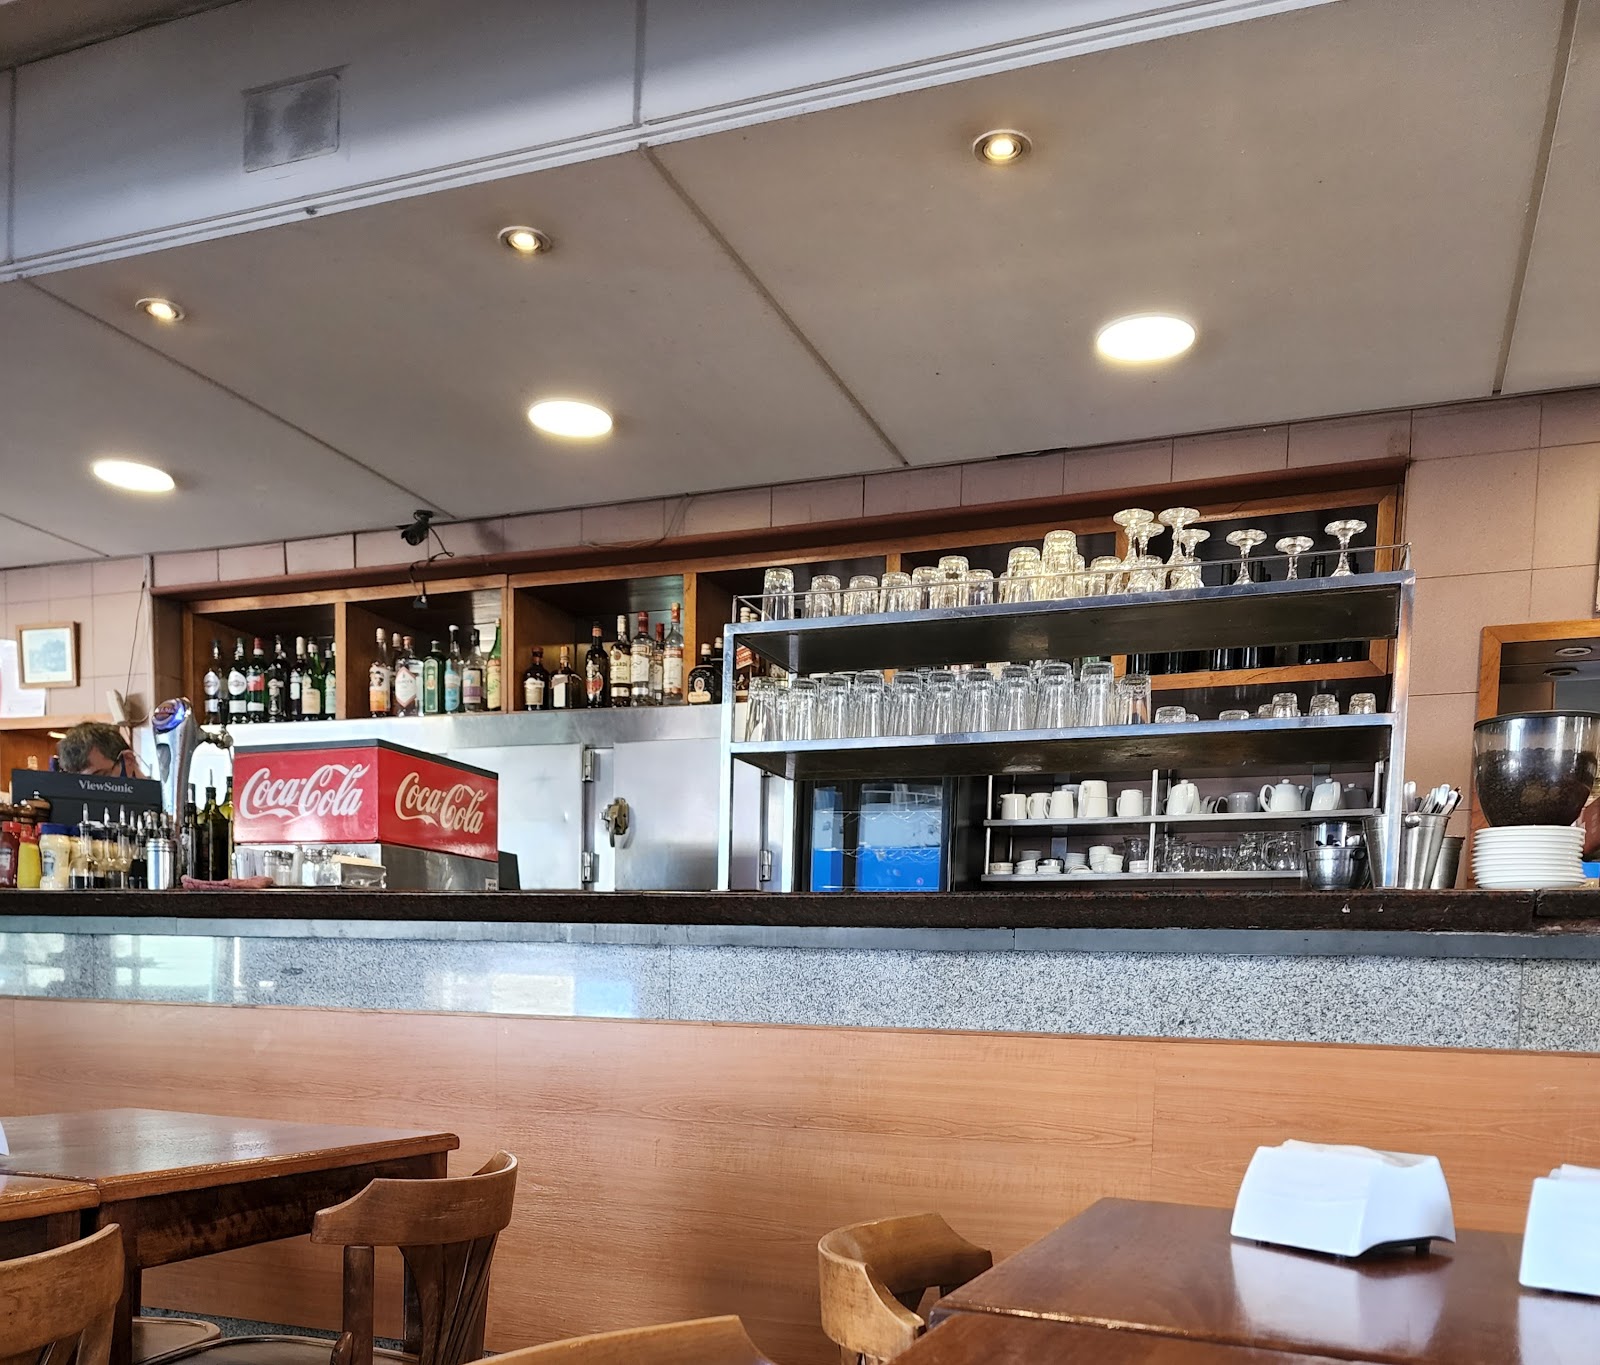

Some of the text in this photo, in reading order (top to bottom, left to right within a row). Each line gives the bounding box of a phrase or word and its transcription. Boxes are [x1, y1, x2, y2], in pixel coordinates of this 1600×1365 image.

[78, 780, 134, 793] ViewSonic
[240, 763, 370, 824] Coca-Cola
[395, 772, 489, 834] Coca-Cola
